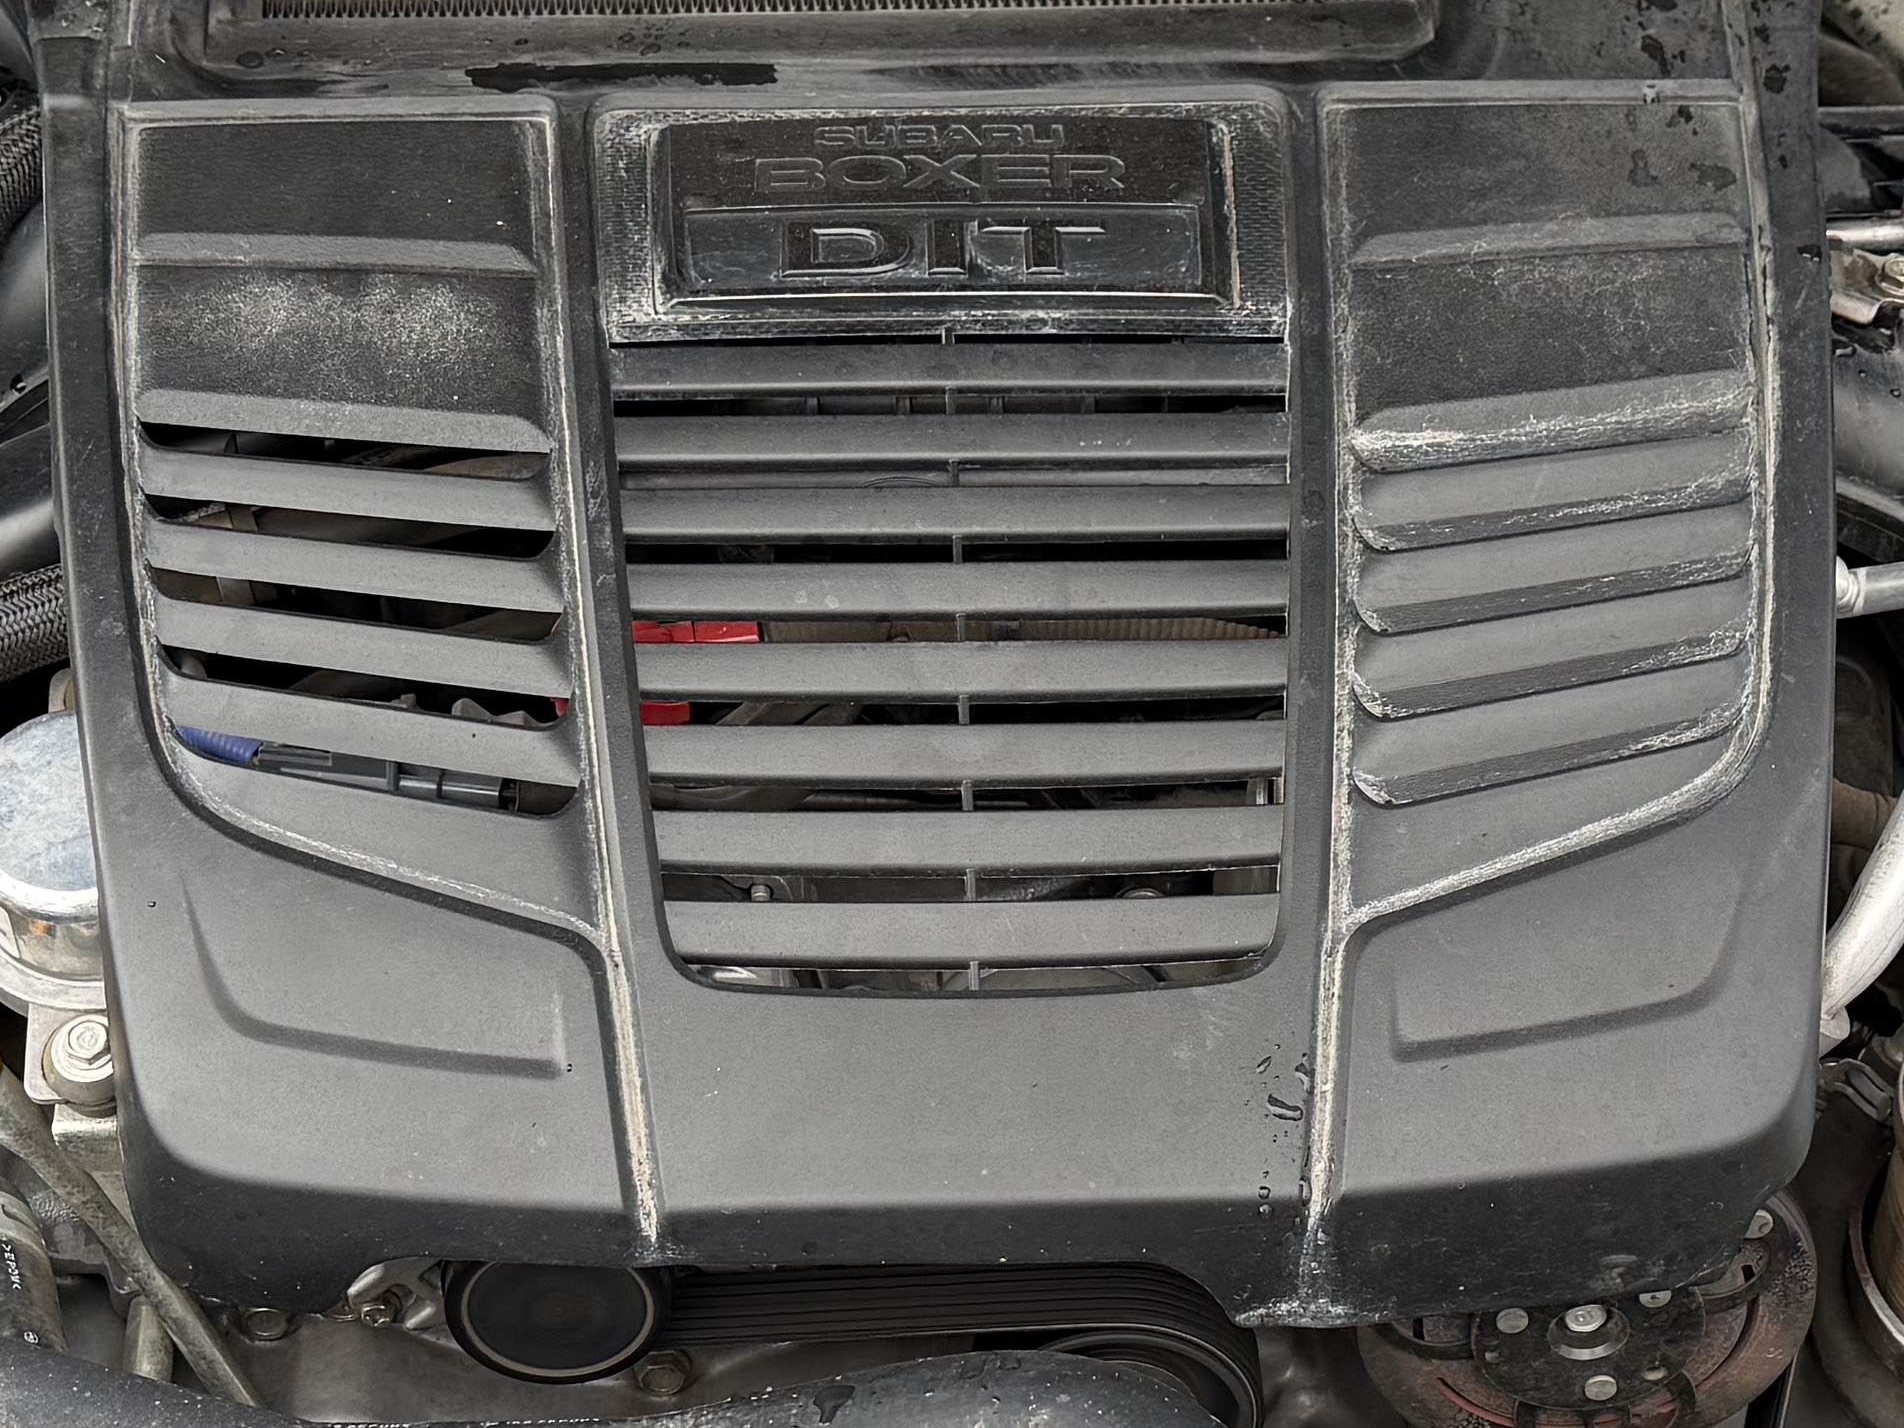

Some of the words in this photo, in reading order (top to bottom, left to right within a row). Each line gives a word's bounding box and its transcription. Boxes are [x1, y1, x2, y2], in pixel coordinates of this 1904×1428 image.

[813, 122, 1066, 150] SUBARU
[755, 154, 1126, 192] BOXER
[780, 219, 1107, 278] DIT
